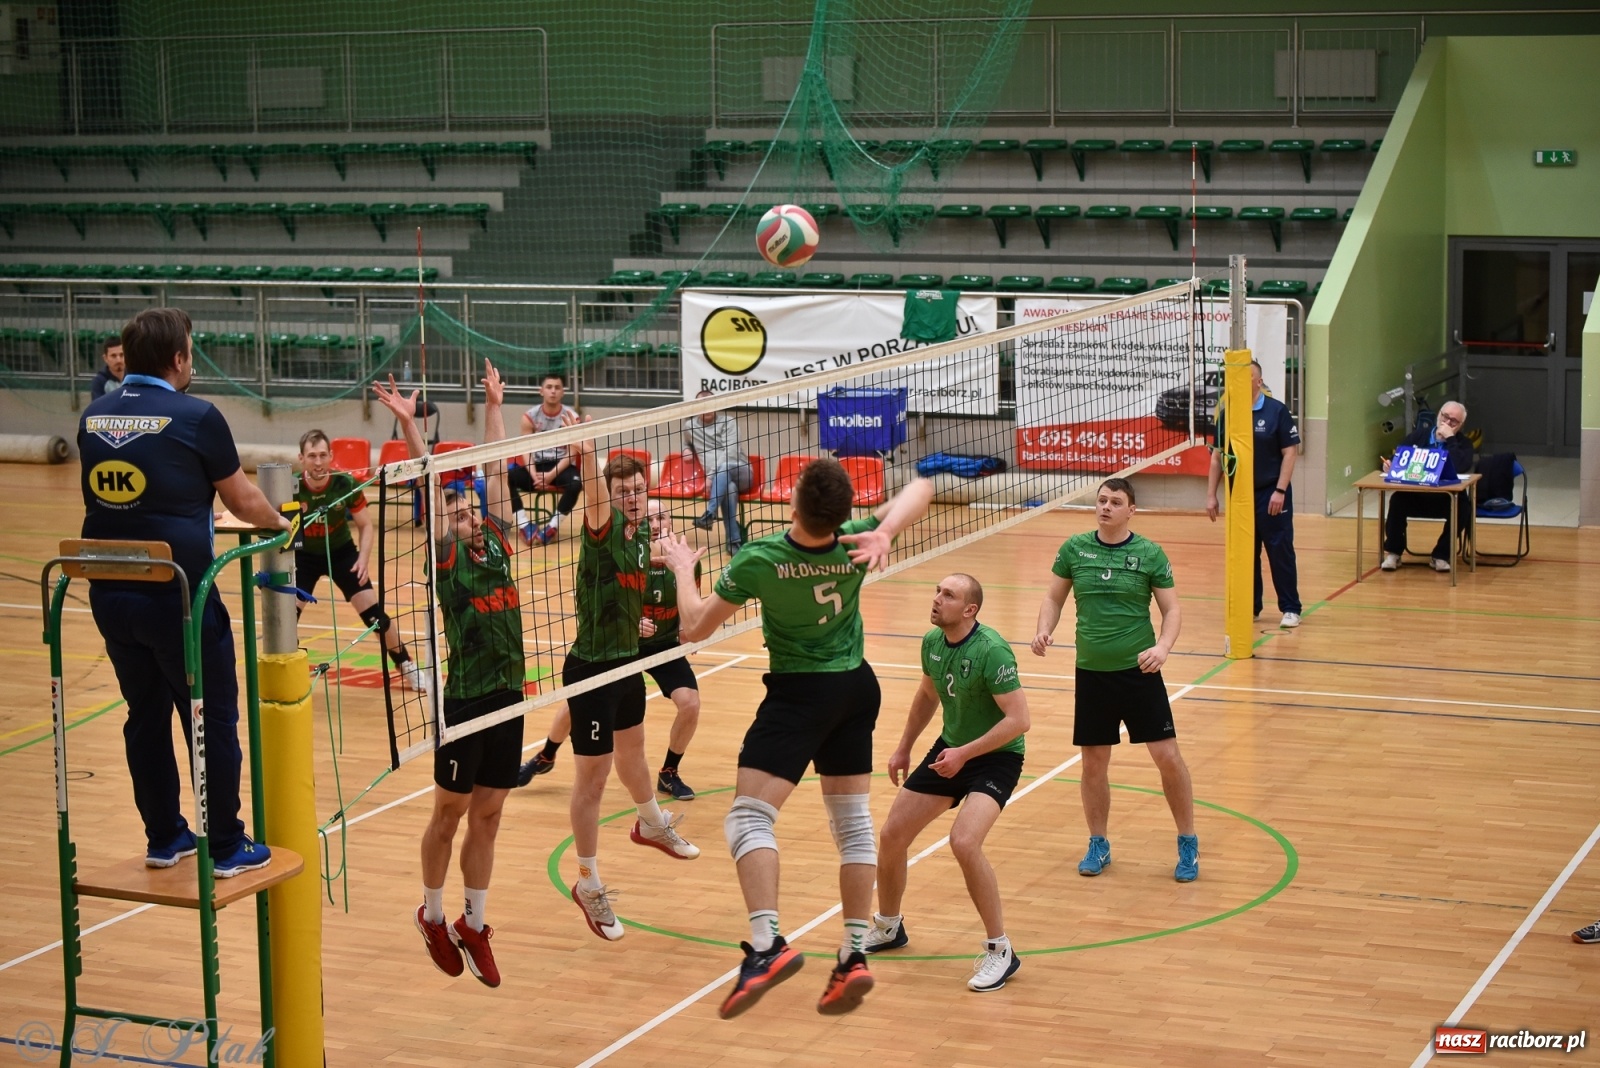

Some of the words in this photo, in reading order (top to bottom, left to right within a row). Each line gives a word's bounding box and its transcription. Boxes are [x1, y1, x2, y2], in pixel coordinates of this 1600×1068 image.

[833, 351, 852, 368] W
[701, 376, 767, 392] RACIBÓR
[90, 419, 161, 431] TWINPIGS
[829, 414, 883, 428] molten
[1038, 430, 1072, 447] 695
[1076, 431, 1109, 448] 496
[1111, 433, 1145, 450] 555
[1168, 456, 1182, 466] 45
[1399, 450, 1410, 466] 8
[1426, 452, 1439, 469] 10
[97, 471, 136, 493] HK
[812, 580, 844, 625] 5
[945, 673, 956, 698] 2
[591, 720, 600, 741] 2
